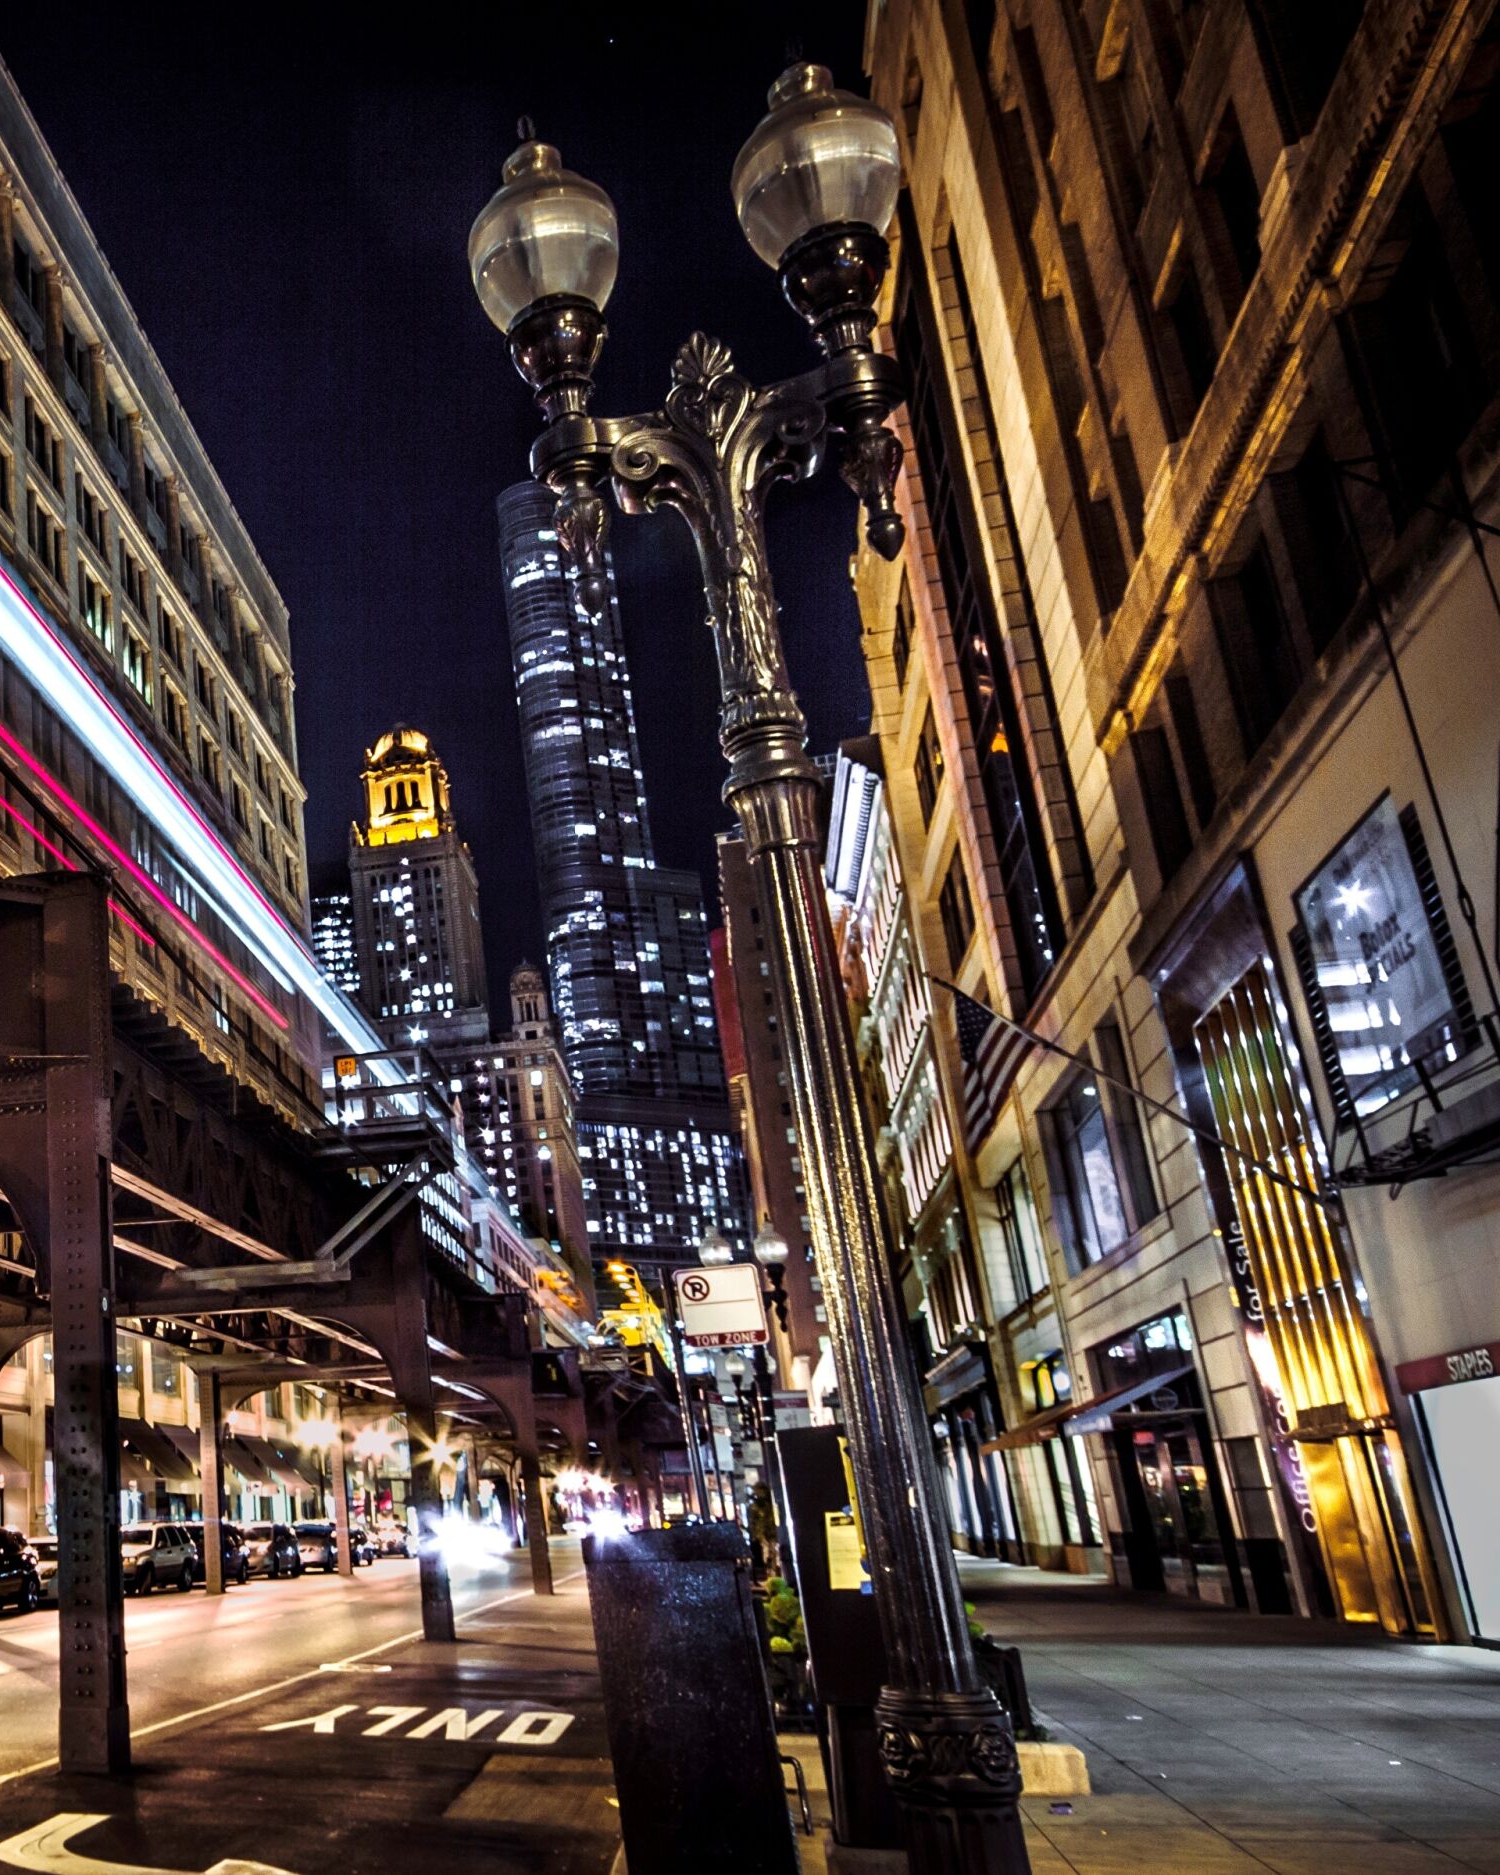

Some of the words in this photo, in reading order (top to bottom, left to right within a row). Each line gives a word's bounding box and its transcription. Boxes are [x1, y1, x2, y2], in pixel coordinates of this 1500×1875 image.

[1228, 1221, 1251, 1276] Sale
[1246, 1284, 1265, 1321] for
[694, 1335, 719, 1346] TOW
[724, 1331, 758, 1344] ZONE
[1446, 1348, 1494, 1381] STAPLES
[257, 1704, 576, 1745] ONLY
